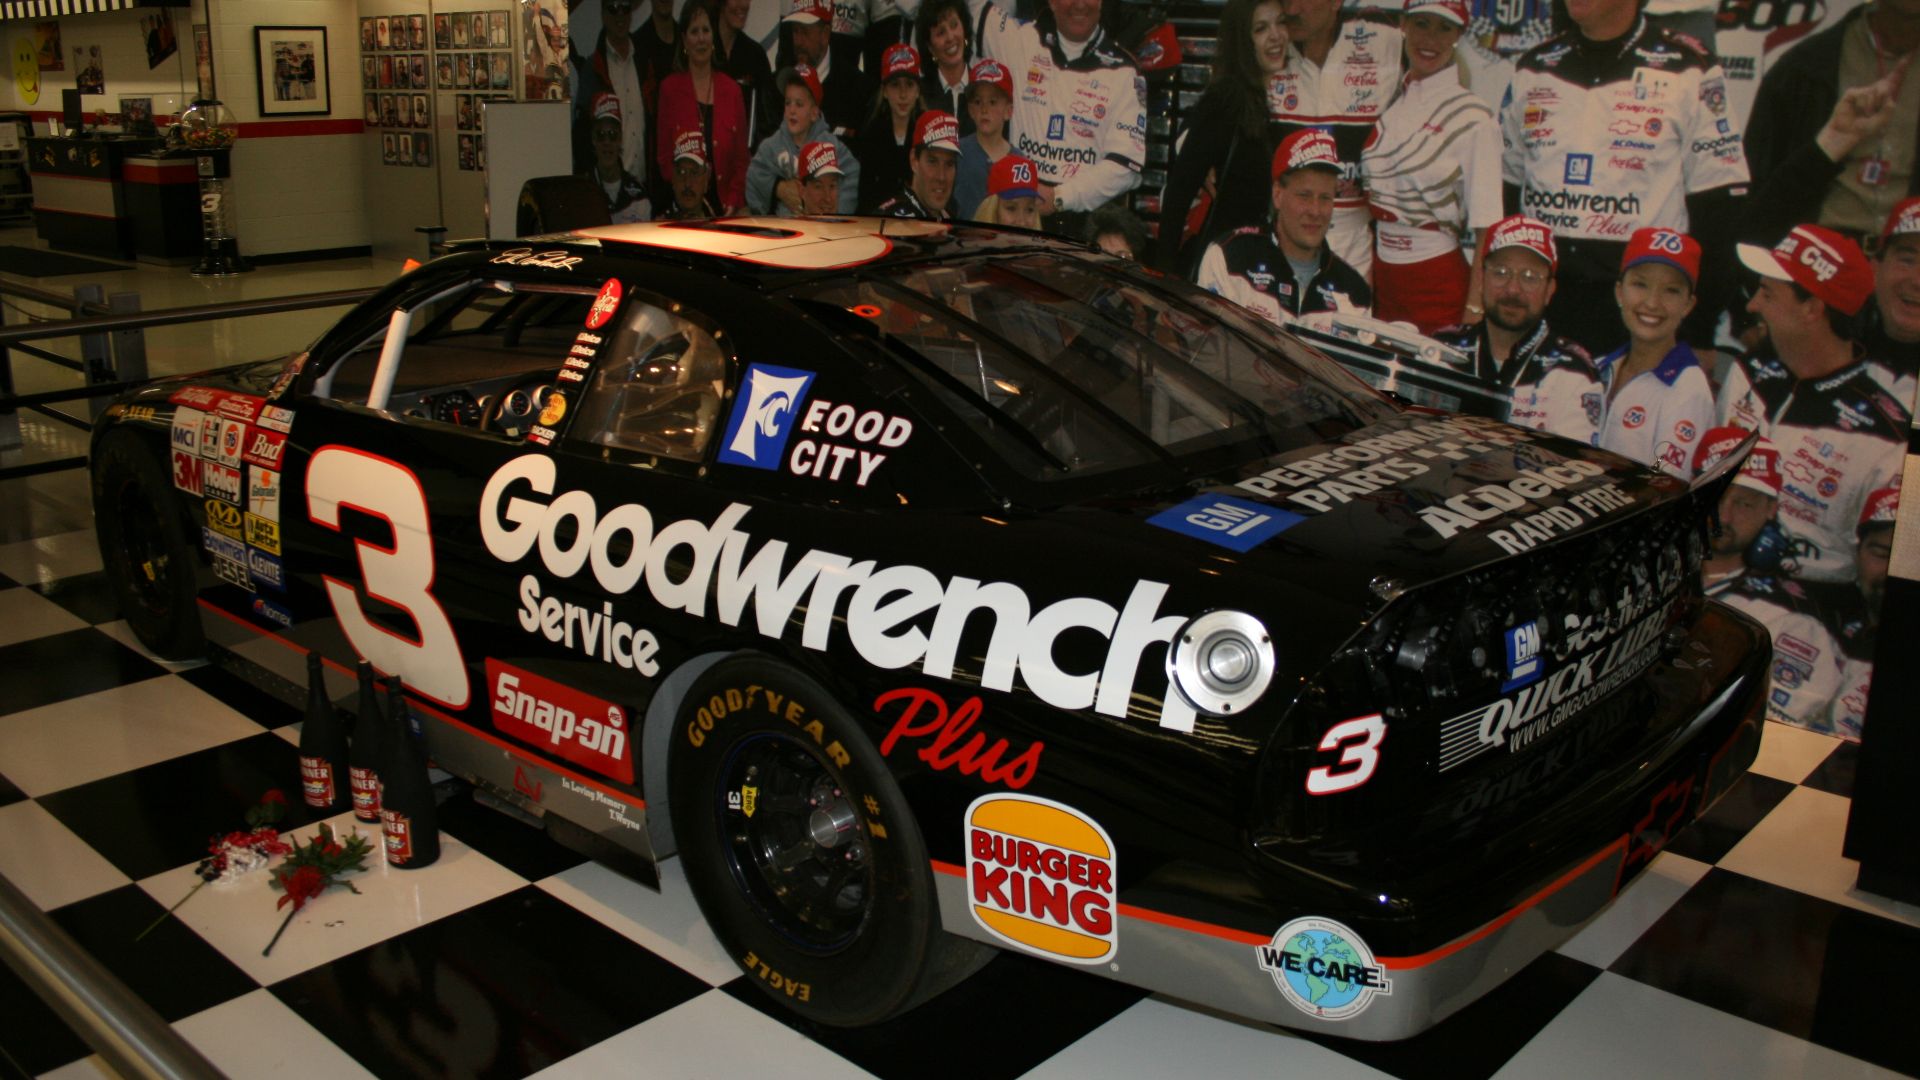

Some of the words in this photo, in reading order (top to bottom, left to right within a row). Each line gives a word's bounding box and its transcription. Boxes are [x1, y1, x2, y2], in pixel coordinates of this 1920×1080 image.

[1018, 132, 1097, 166] Goodwrench
[1012, 163, 1032, 183] 76
[201, 193, 221, 214] 3
[1523, 187, 1641, 215] Goodwrench
[1535, 210, 1579, 229] Service
[1586, 213, 1631, 236] Plus
[1649, 233, 1683, 253] 76
[1800, 245, 1838, 282] Cup
[172, 427, 195, 448] MCI
[249, 433, 286, 460] Bud
[800, 399, 914, 450] FOOD
[174, 451, 206, 497] 3M
[788, 438, 887, 487] CITY
[1286, 456, 1431, 513] PARTS
[1794, 448, 1843, 479] Snap-on
[1185, 502, 1256, 534] GM
[1420, 457, 1605, 540] ACDelco
[1486, 508, 1583, 556] RAPID
[1567, 481, 1637, 534] FIRE
[1783, 484, 1829, 510] ACDelco
[304, 443, 472, 711] 3
[479, 453, 1198, 734] Goodwrench
[518, 574, 661, 679] Service
[1513, 621, 1541, 660] GM
[494, 671, 626, 761] Snap-on
[1477, 644, 1608, 748] QUICK
[687, 685, 853, 770] GOODYEAR
[874, 687, 1045, 790] Plus
[1305, 713, 1389, 797] 3
[570, 781, 596, 801] Loving
[595, 791, 628, 813] Memory
[863, 793, 888, 840] #1
[970, 828, 1114, 895] BURGER
[972, 860, 1113, 937] KING
[744, 950, 812, 1003] EAGLE
[1262, 947, 1302, 974] WE
[1304, 956, 1386, 990] CARE.
